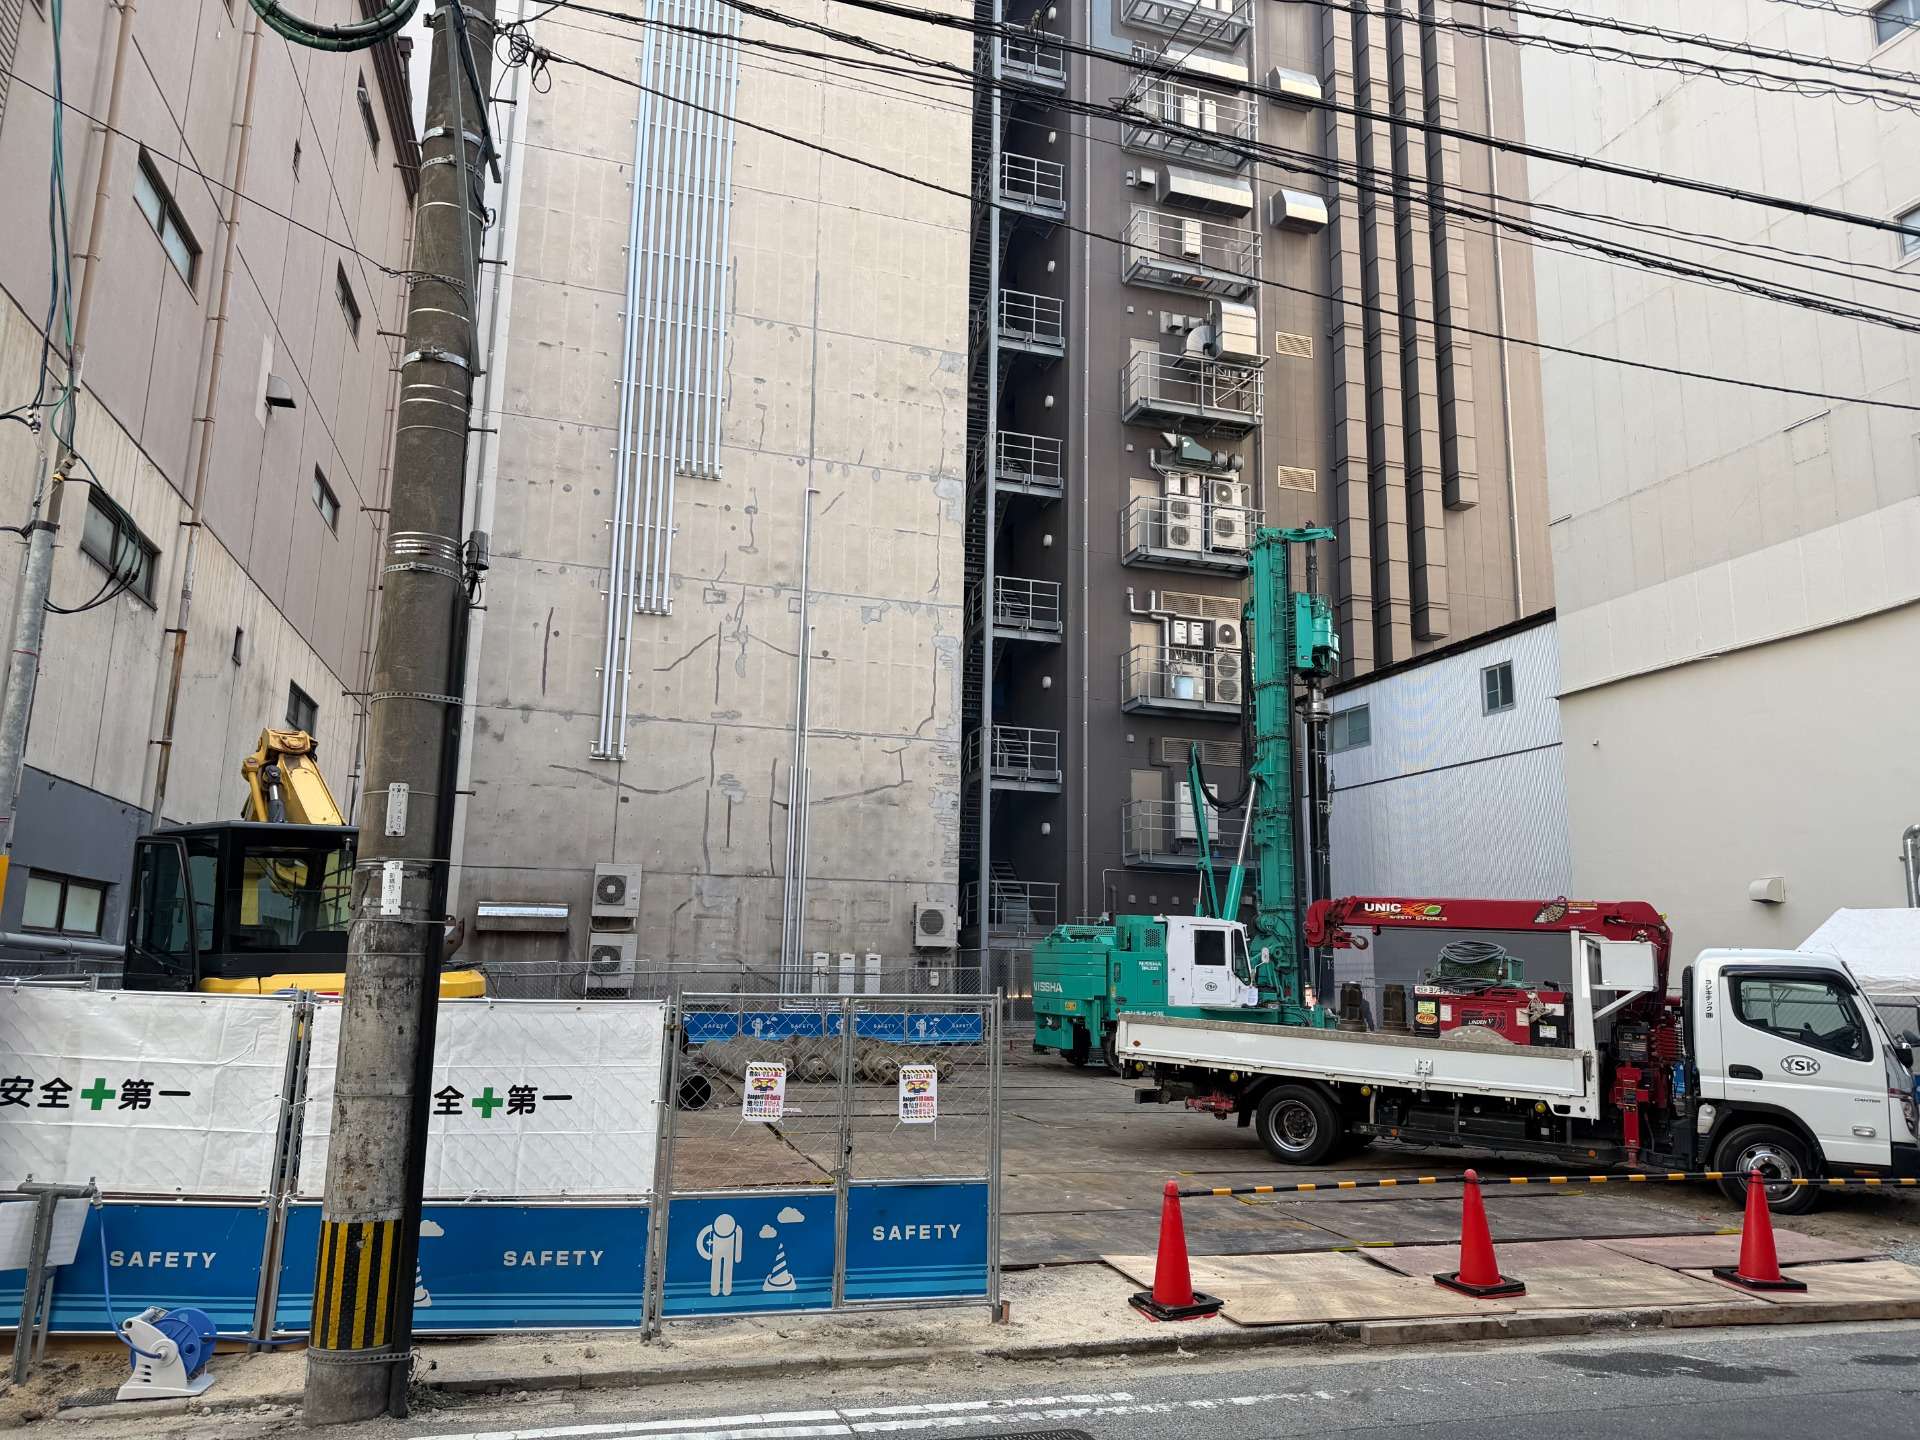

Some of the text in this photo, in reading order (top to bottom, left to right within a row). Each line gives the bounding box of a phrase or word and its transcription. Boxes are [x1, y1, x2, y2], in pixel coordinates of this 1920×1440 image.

[1364, 902, 1402, 912] UNIC
[1783, 1057, 1819, 1073] YSK
[873, 1223, 961, 1241] SAFETY
[109, 1250, 217, 1269] SAFETY
[503, 1250, 604, 1267] SAFETY
